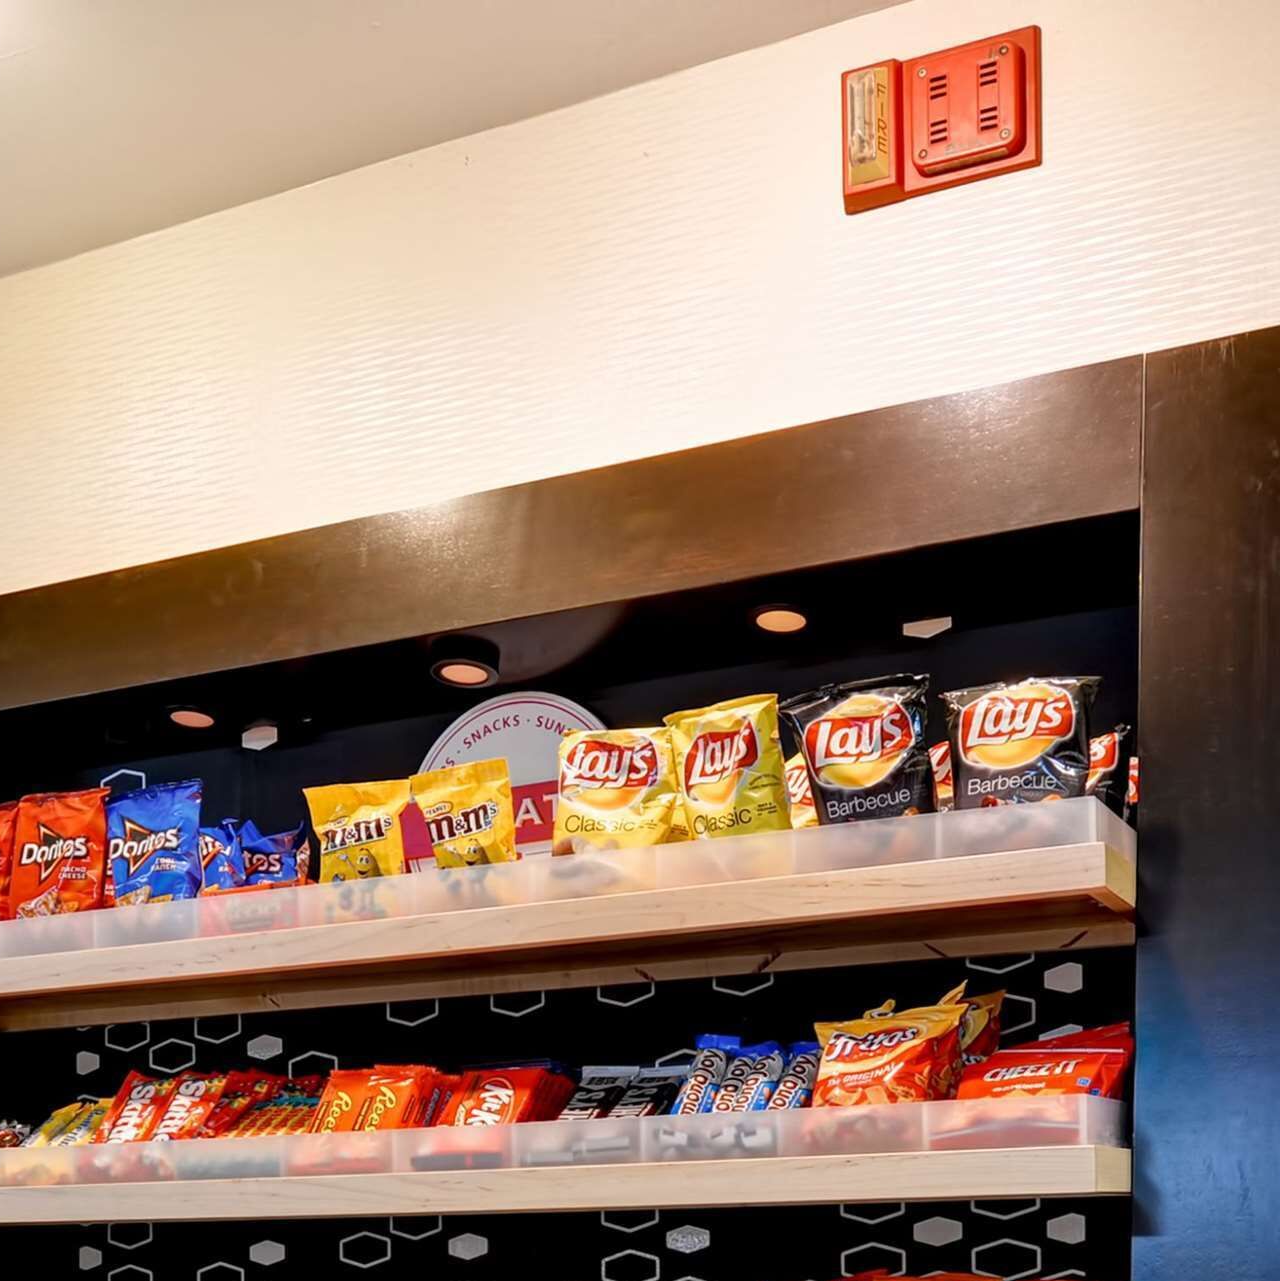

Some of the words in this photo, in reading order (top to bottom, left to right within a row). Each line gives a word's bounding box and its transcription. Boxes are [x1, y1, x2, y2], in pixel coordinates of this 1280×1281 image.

[876, 82, 888, 155] FIRE
[463, 714, 521, 749] SNACKS
[816, 709, 903, 767] Lay's
[967, 697, 1065, 748] Lay's
[561, 741, 654, 788] Lay's
[689, 724, 751, 787] Lay's
[967, 772, 1057, 796] Barbecue
[827, 788, 912, 818] Barbecue
[565, 814, 635, 833] Classic
[692, 806, 752, 835] Classic
[21, 837, 88, 865] Doritos
[109, 828, 179, 859] Doritos
[825, 1028, 918, 1061] Fritos
